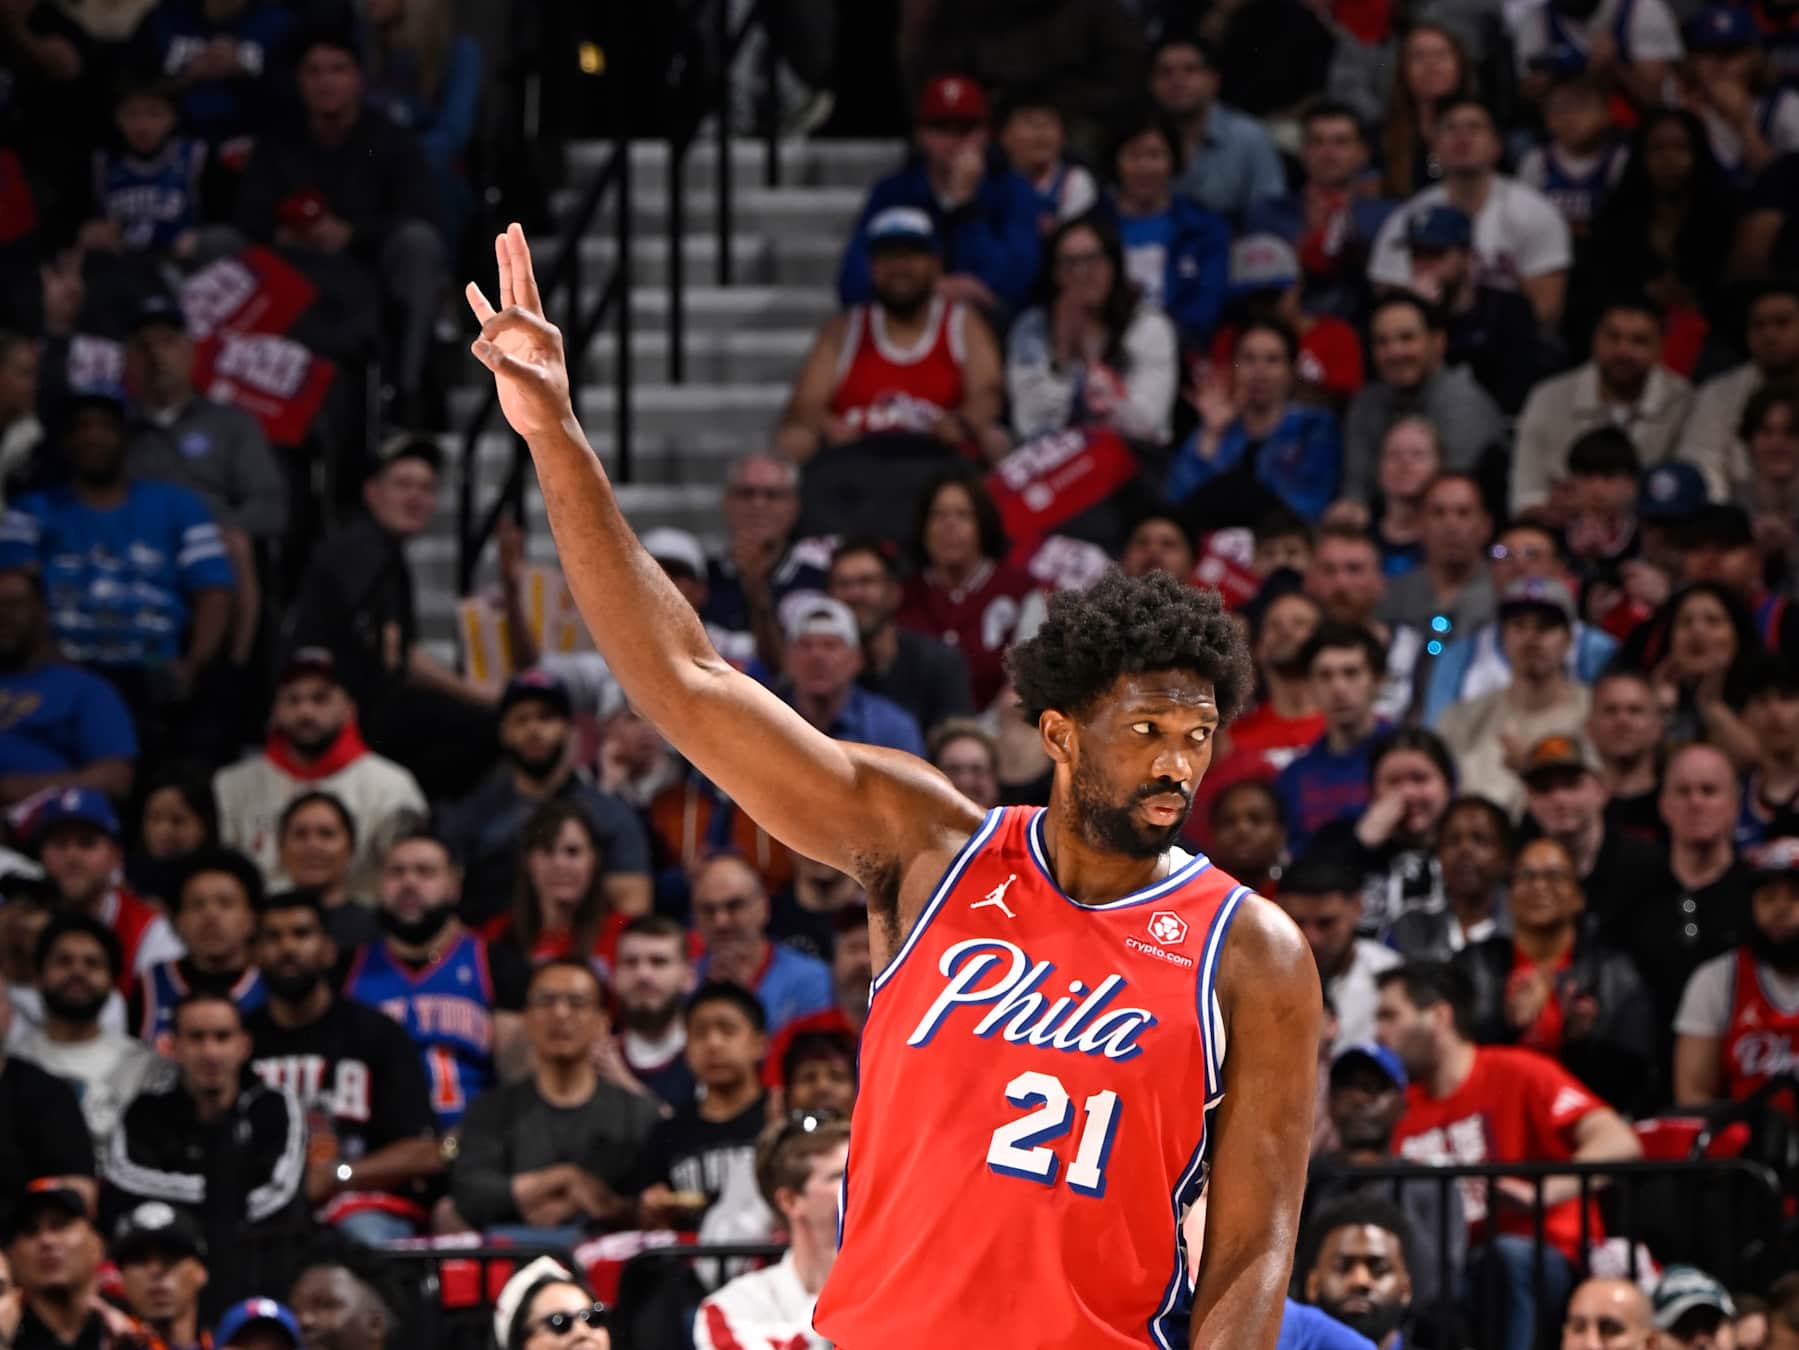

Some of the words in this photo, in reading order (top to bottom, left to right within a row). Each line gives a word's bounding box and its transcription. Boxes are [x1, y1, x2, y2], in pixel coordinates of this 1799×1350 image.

[905, 937, 1159, 1063] Phila
[1125, 937, 1193, 968] crypto.com
[986, 1070, 1124, 1200] 21
